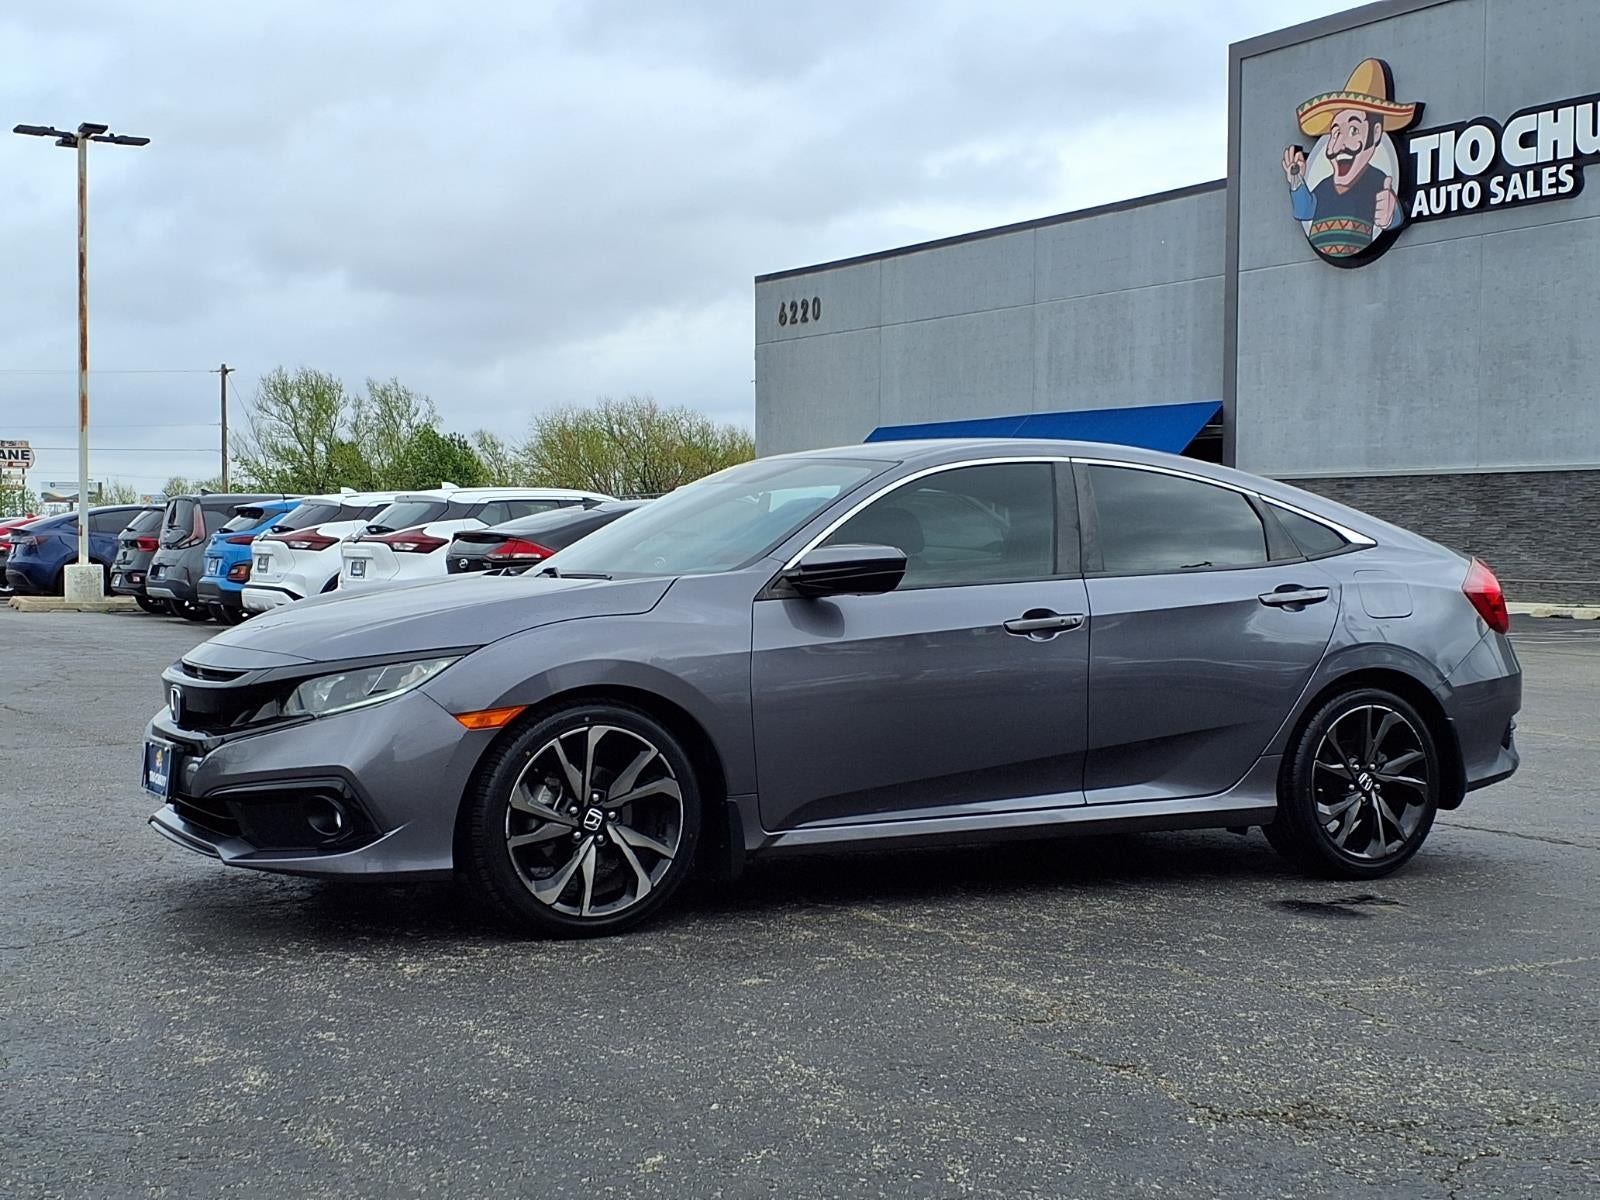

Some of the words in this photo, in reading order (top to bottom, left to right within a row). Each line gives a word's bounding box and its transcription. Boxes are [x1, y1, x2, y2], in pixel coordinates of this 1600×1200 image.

[1409, 124, 1496, 185] TIO
[1411, 180, 1482, 218] AUTO
[1490, 164, 1574, 205] SALES
[779, 296, 821, 326] 6220
